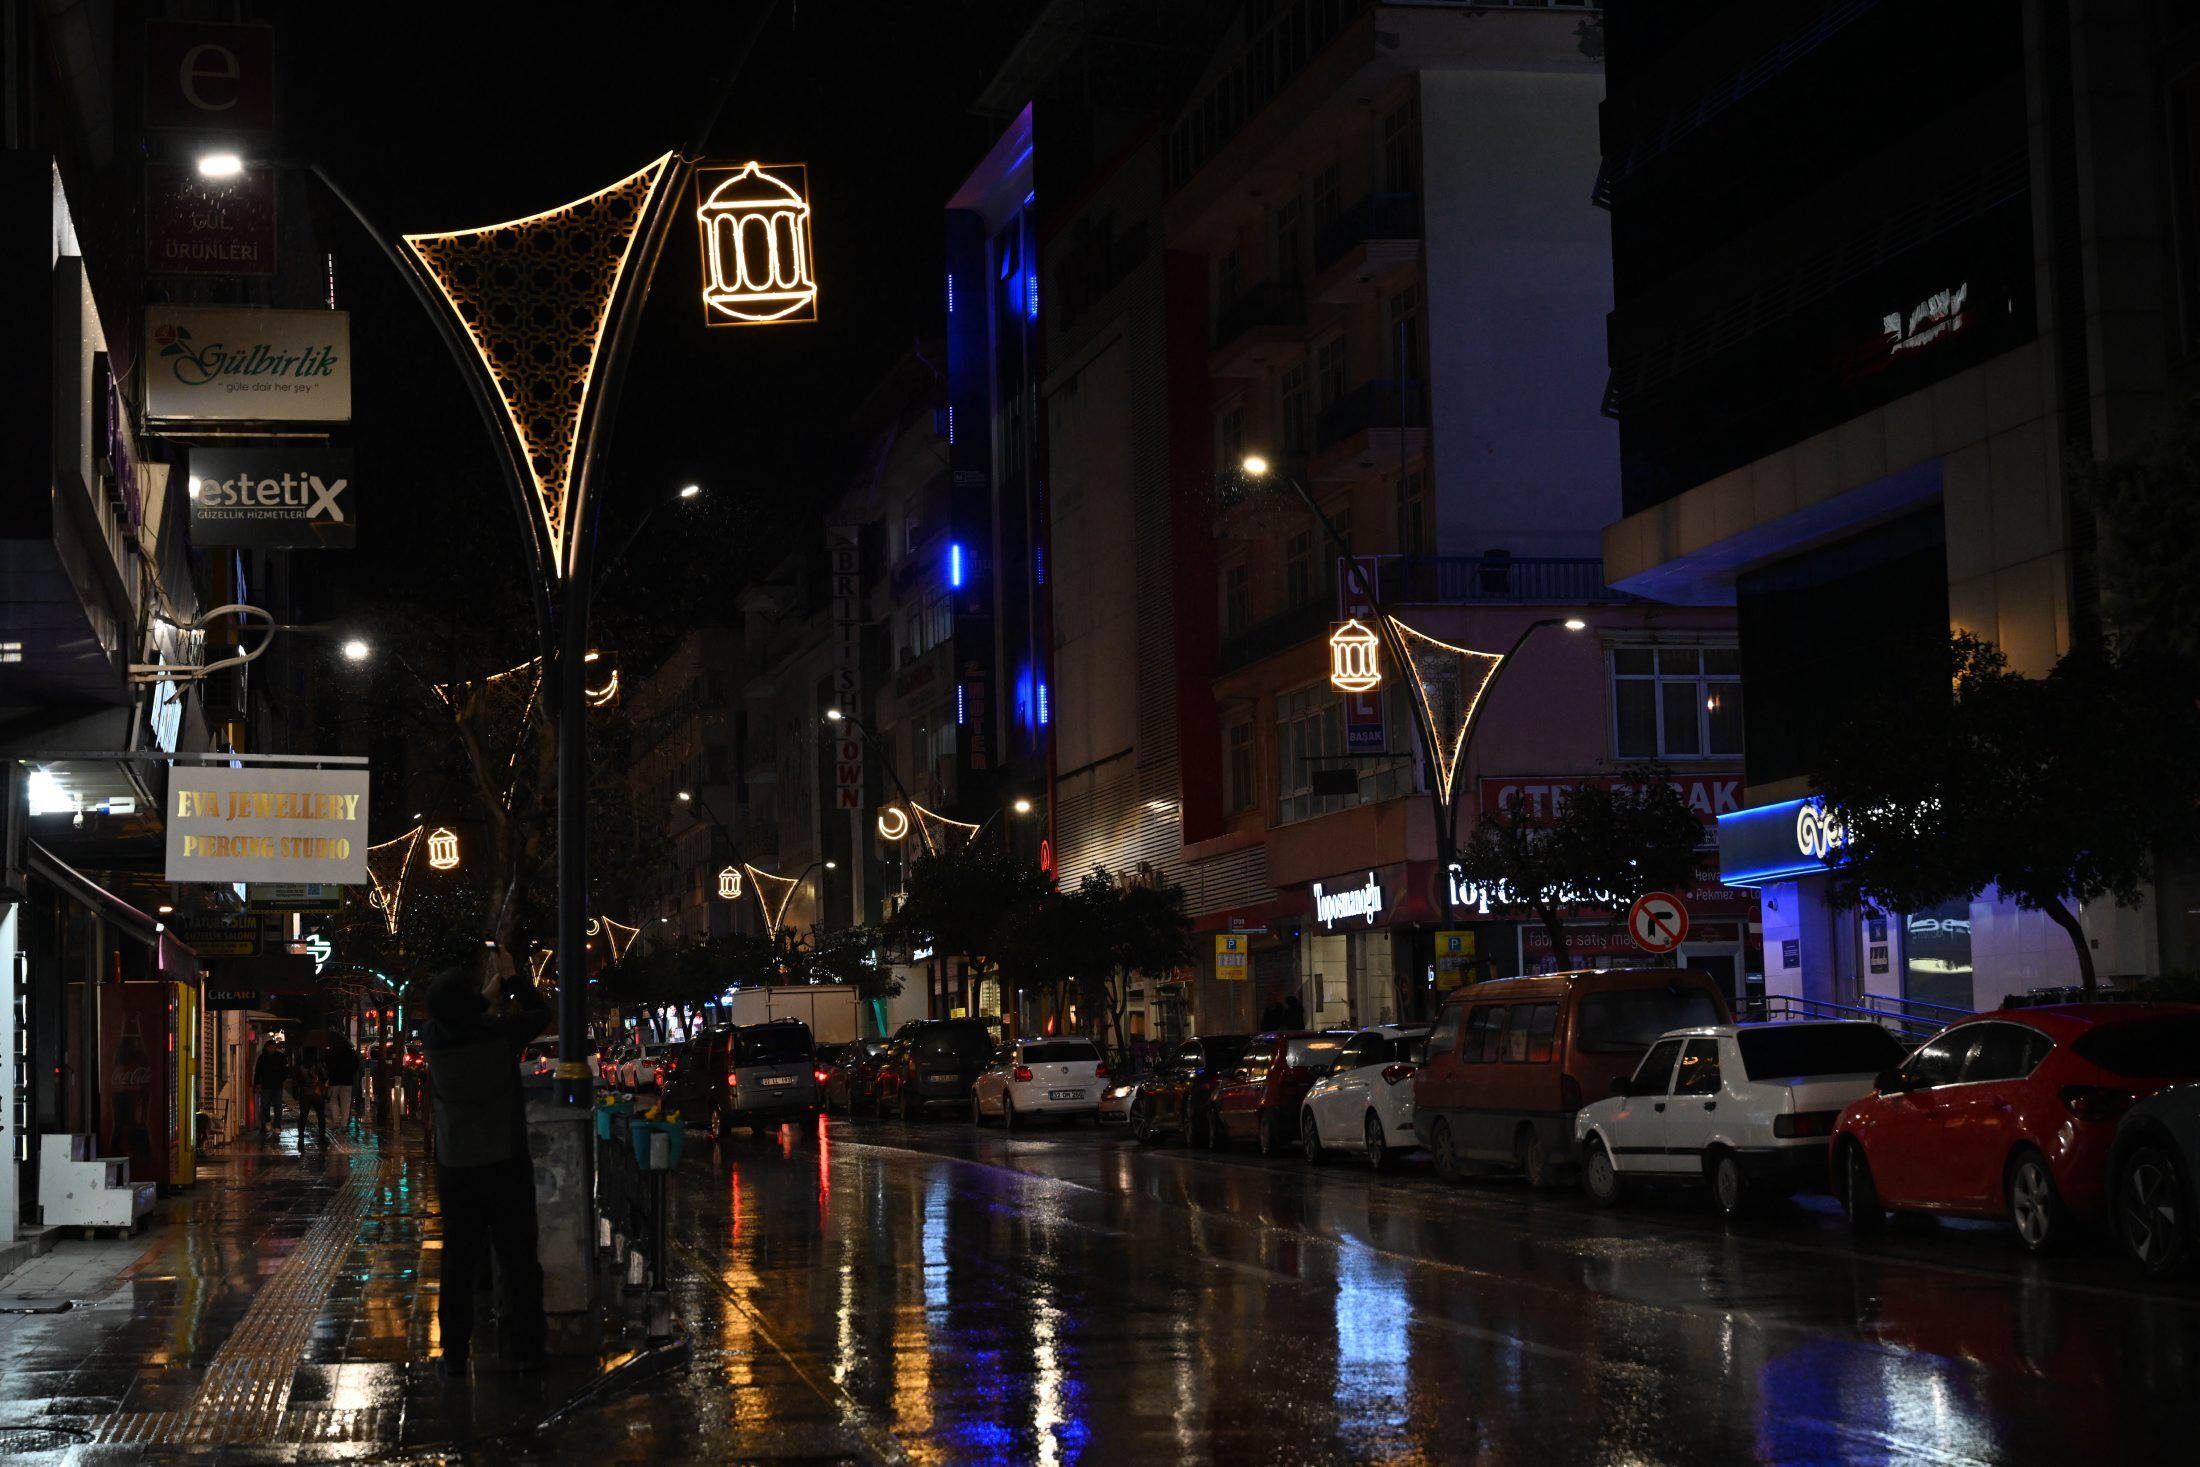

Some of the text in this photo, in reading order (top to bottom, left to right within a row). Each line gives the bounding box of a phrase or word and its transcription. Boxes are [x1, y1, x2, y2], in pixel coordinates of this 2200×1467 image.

[179, 43, 241, 112] e
[165, 240, 259, 261] ÜRÜNLERİ
[174, 343, 337, 386] Gülbirlik
[252, 382, 272, 392] dair
[275, 382, 293, 392] her
[295, 383, 311, 394] şey
[178, 790, 359, 821] EVA JEWELLERY
[184, 835, 350, 860] PIERCING STUDIO
[1696, 888, 1736, 900] Pekmez
[1529, 928, 1573, 947] faba
